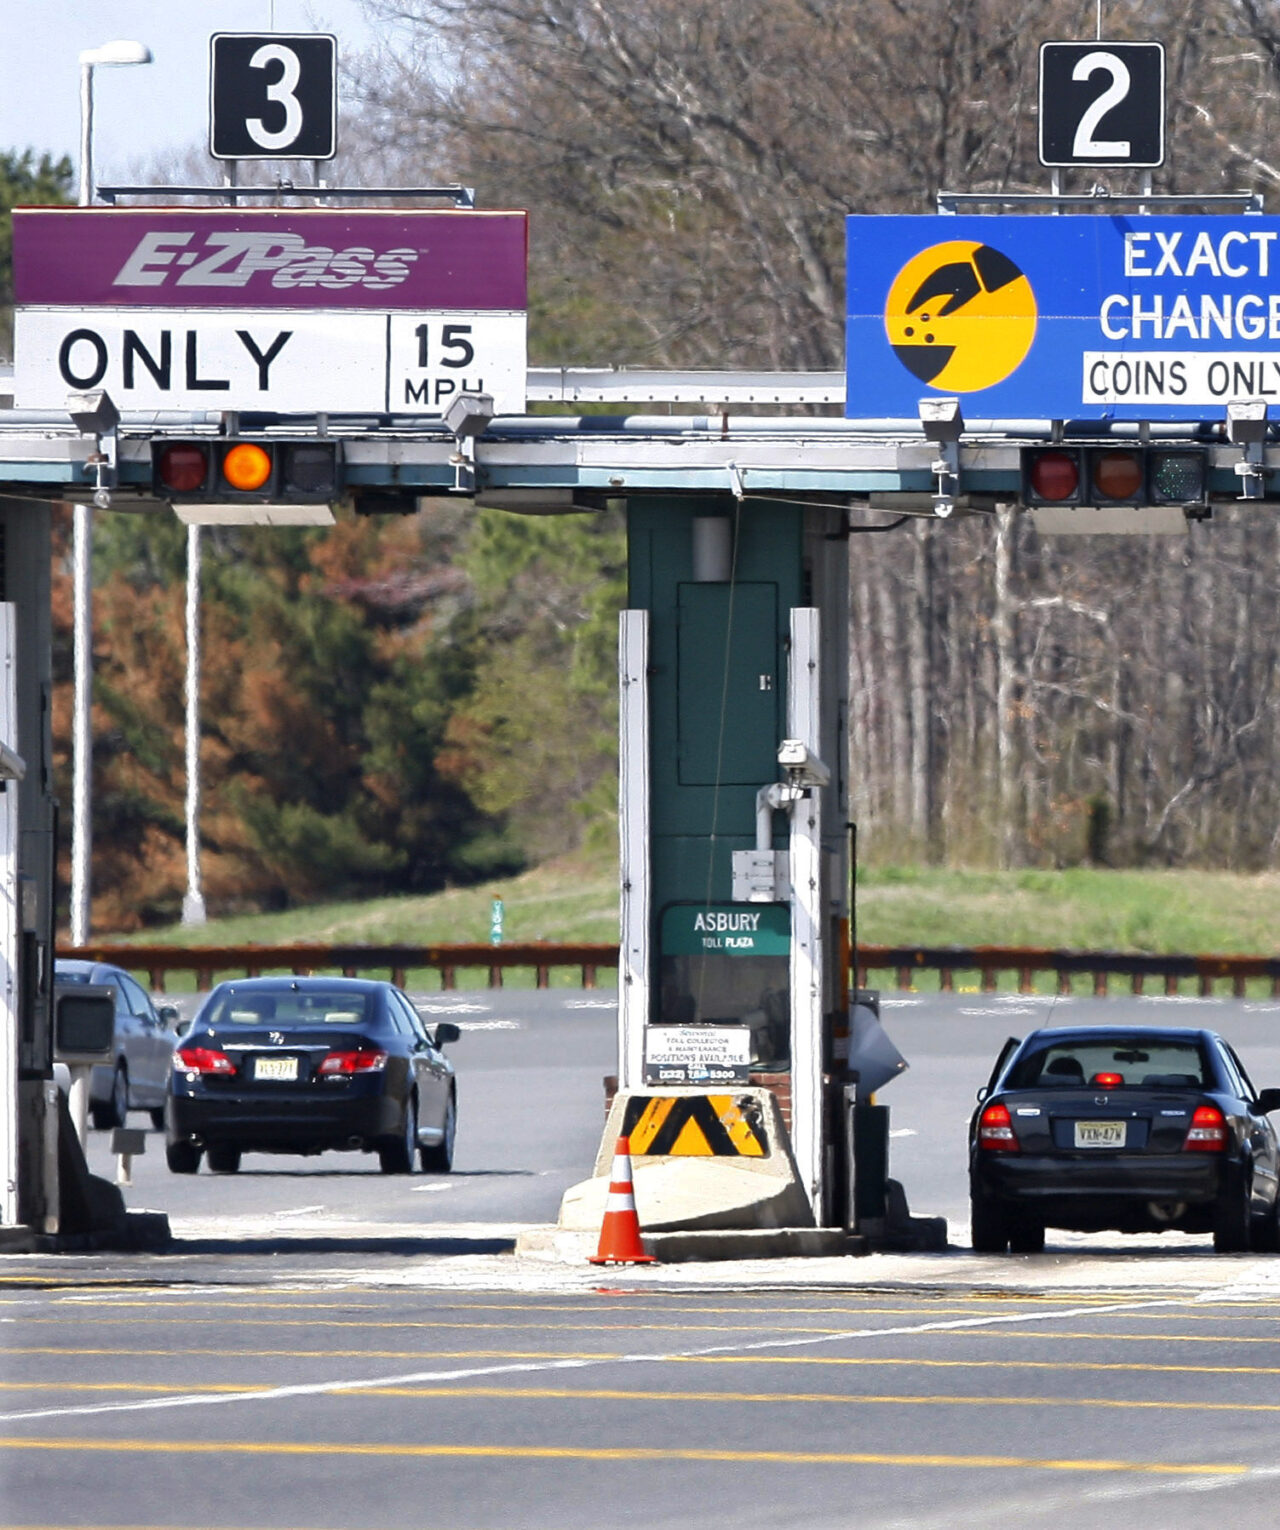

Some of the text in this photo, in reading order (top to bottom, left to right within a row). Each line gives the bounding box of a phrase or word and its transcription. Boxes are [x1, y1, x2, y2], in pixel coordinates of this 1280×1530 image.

[245, 43, 303, 150] 3
[1071, 51, 1131, 158] 2
[1123, 231, 1278, 277] EXACT
[58, 328, 294, 391] ONLY
[415, 323, 474, 369] 15
[1089, 360, 1188, 396] COINS
[694, 912, 761, 932] ASBURY
[702, 937, 754, 948] TOLL PLAZA
